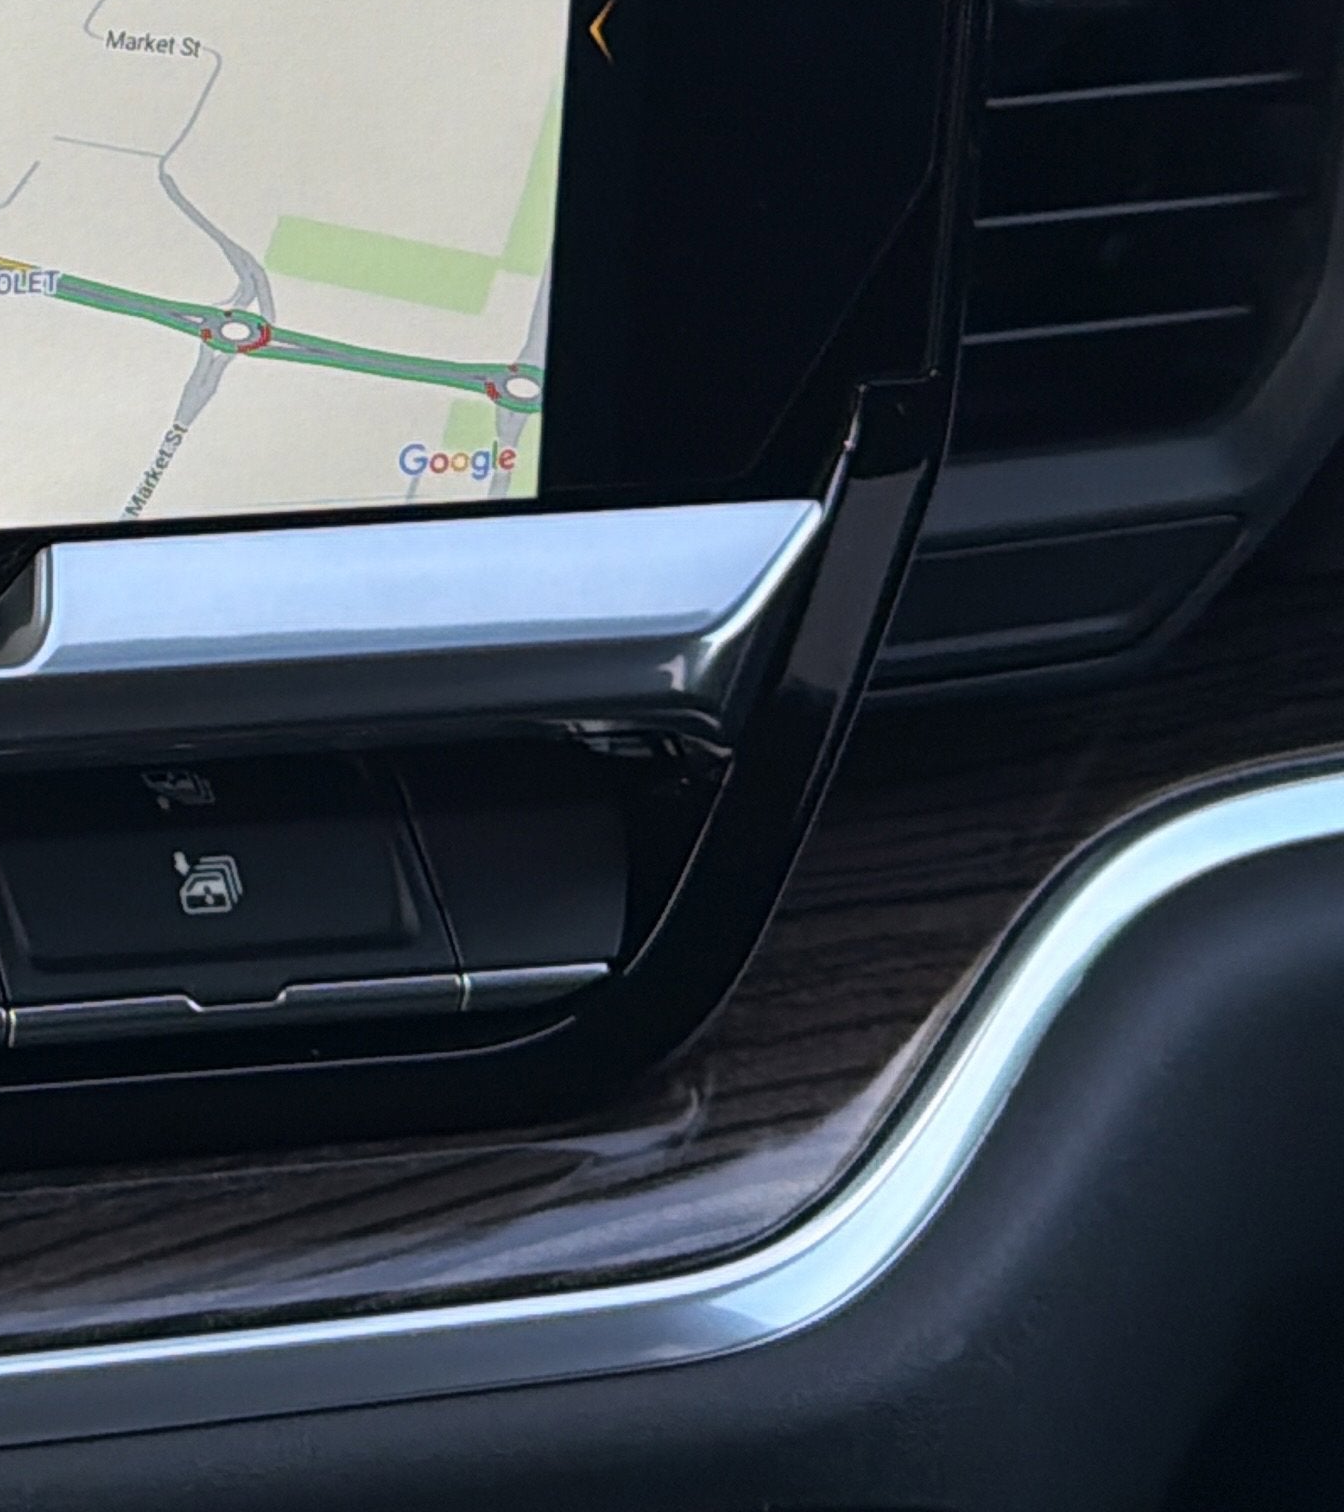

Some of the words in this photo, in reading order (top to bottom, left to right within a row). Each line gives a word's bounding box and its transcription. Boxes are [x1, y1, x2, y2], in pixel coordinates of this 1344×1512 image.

[105, 29, 178, 56] Market
[182, 36, 201, 58] St
[124, 447, 174, 517] Market
[165, 423, 189, 447] St
[398, 442, 517, 480] Google
